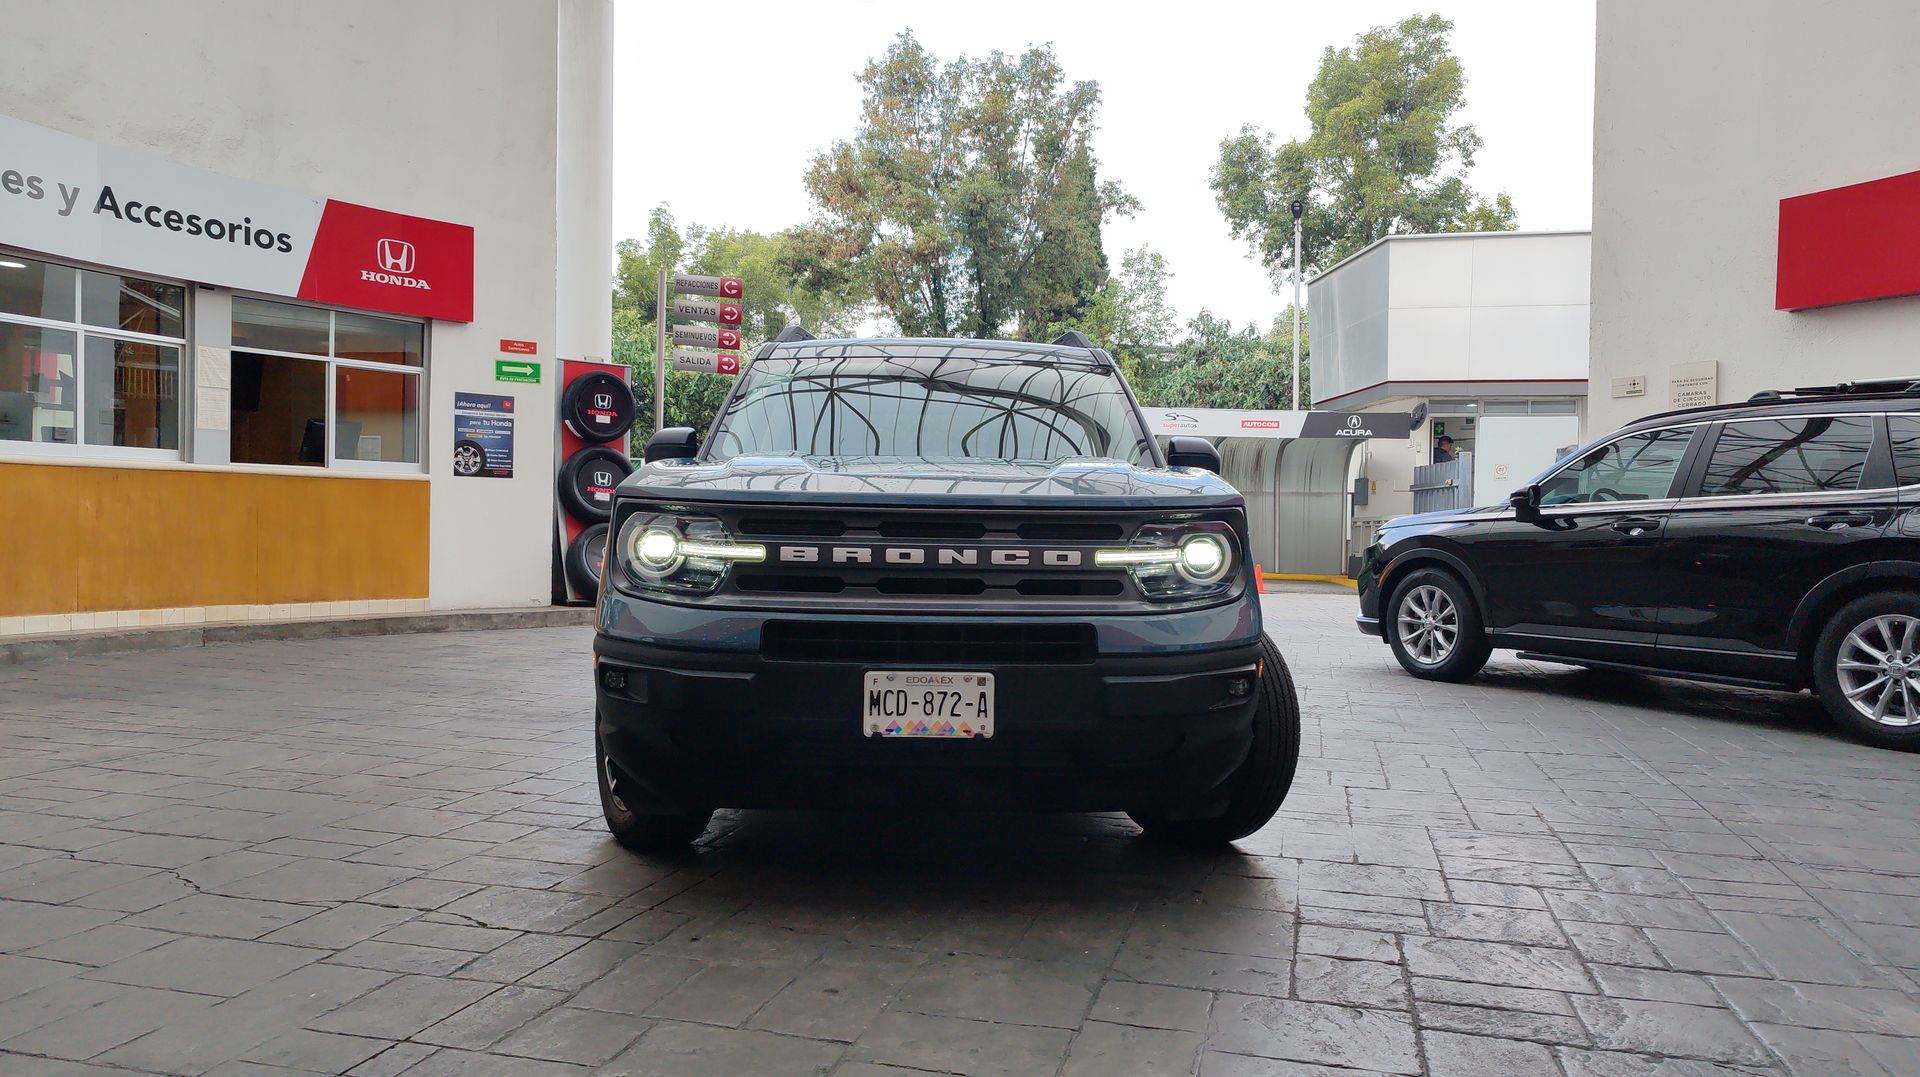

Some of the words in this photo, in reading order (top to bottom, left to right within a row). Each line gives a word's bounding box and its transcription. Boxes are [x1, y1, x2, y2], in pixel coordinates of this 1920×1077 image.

[57, 182, 81, 217] y
[92, 185, 293, 253] Accesorios
[360, 270, 431, 290] HONDA
[676, 279, 719, 290] REFACCIONES
[679, 305, 716, 316] VENTAS
[674, 330, 717, 341] SEMINUEVOS
[679, 356, 712, 366] SALIDA
[587, 409, 618, 417] HONDA
[1242, 421, 1278, 429] AUTOCOM
[1335, 428, 1373, 436] ACURA
[779, 546, 1082, 566] BRONCO
[869, 689, 988, 718] MCD-872-A
